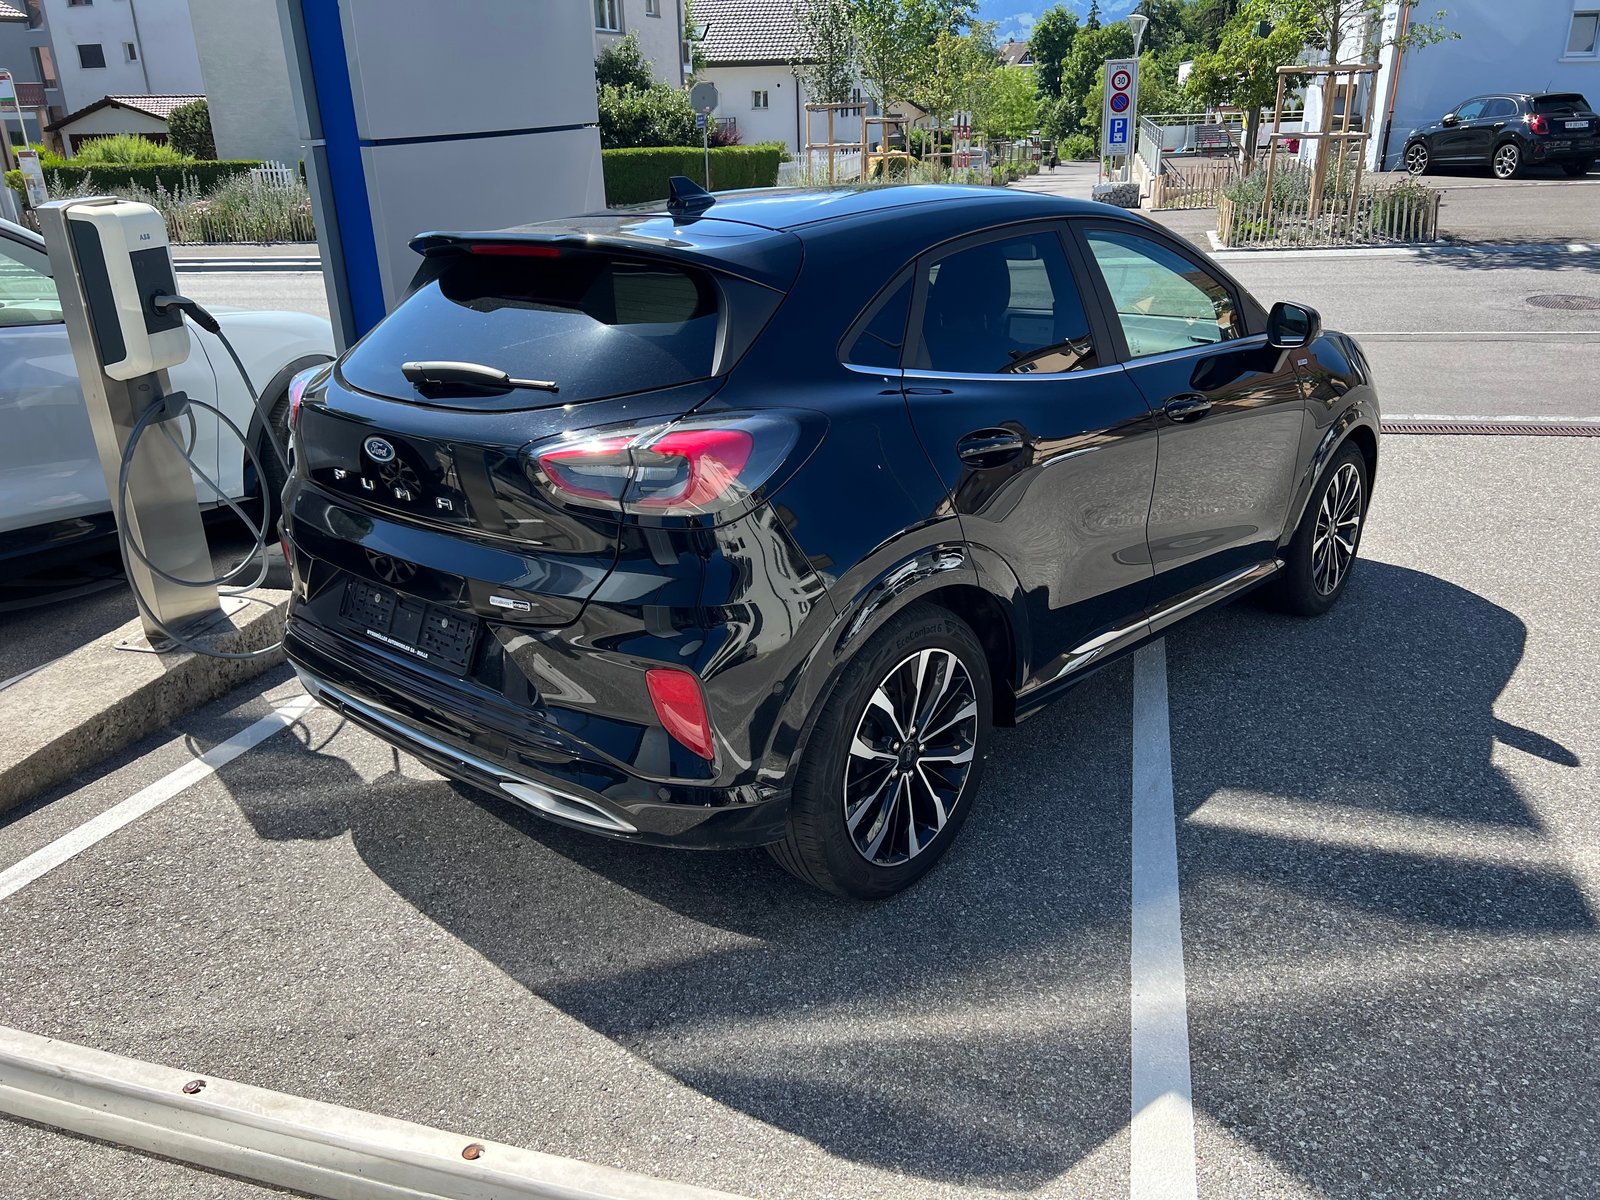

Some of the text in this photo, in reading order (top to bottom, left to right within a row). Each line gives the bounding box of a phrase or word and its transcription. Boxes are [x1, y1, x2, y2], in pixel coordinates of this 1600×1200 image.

[1117, 77, 1126, 85] 30
[1115, 120, 1123, 132] P
[370, 441, 388, 457] Ford
[333, 468, 453, 511] PUMA
